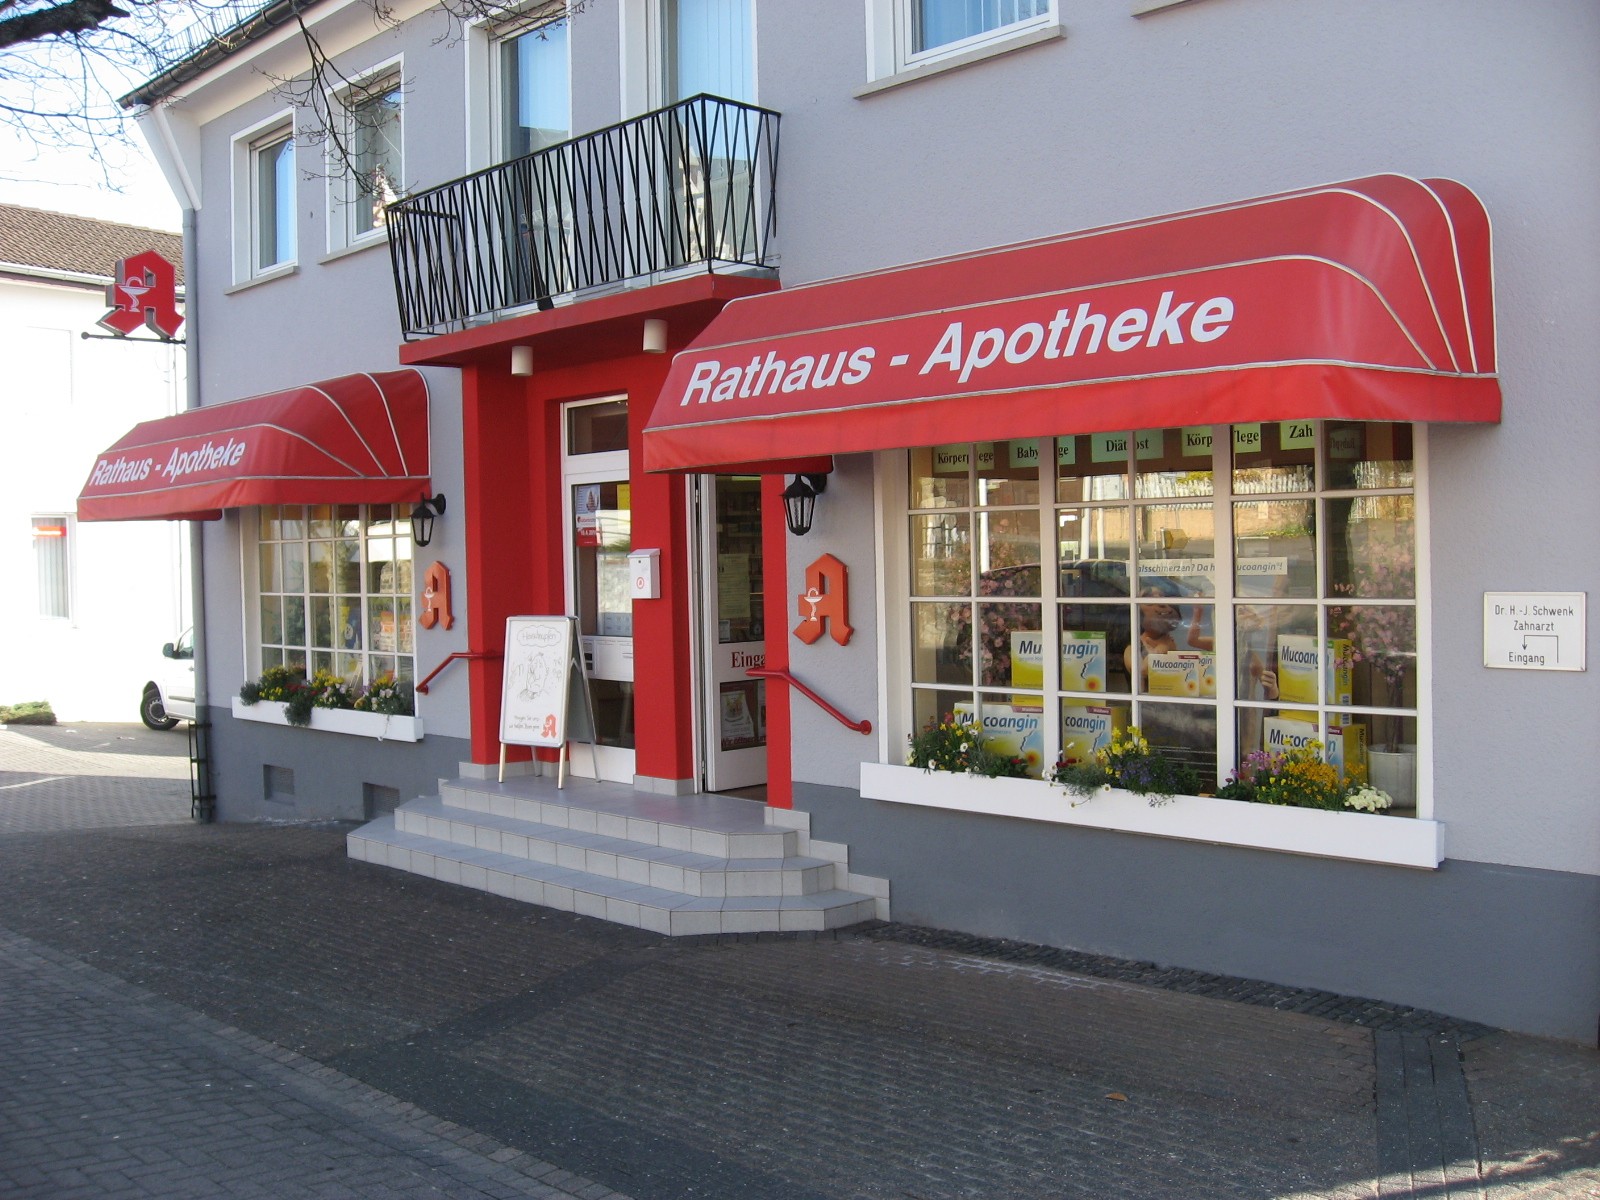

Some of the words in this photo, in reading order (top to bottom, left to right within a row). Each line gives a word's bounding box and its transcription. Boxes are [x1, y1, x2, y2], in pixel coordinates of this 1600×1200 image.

[680, 345, 876, 407] Rathaus
[920, 290, 1234, 384] Apotheke
[1105, 438, 1150, 452] Diätost
[1186, 429, 1260, 447] Körplege
[89, 455, 153, 487] Rathaus
[161, 437, 247, 484] Apotheke
[1017, 446, 1069, 460] Babyge
[1137, 562, 1195, 574] alsschmerzen?
[1495, 604, 1507, 615] Dr.
[1533, 605, 1574, 617] Schwenk
[1513, 620, 1555, 631] Zahnarzt
[1019, 640, 1099, 659] Mungin
[1281, 645, 1329, 669] Mucoang
[1508, 651, 1545, 666] Eingang
[731, 651, 766, 669] Einga
[1152, 659, 1195, 671] Mucoangin
[961, 712, 1038, 732] Mcoangin
[1064, 715, 1106, 733] coangin
